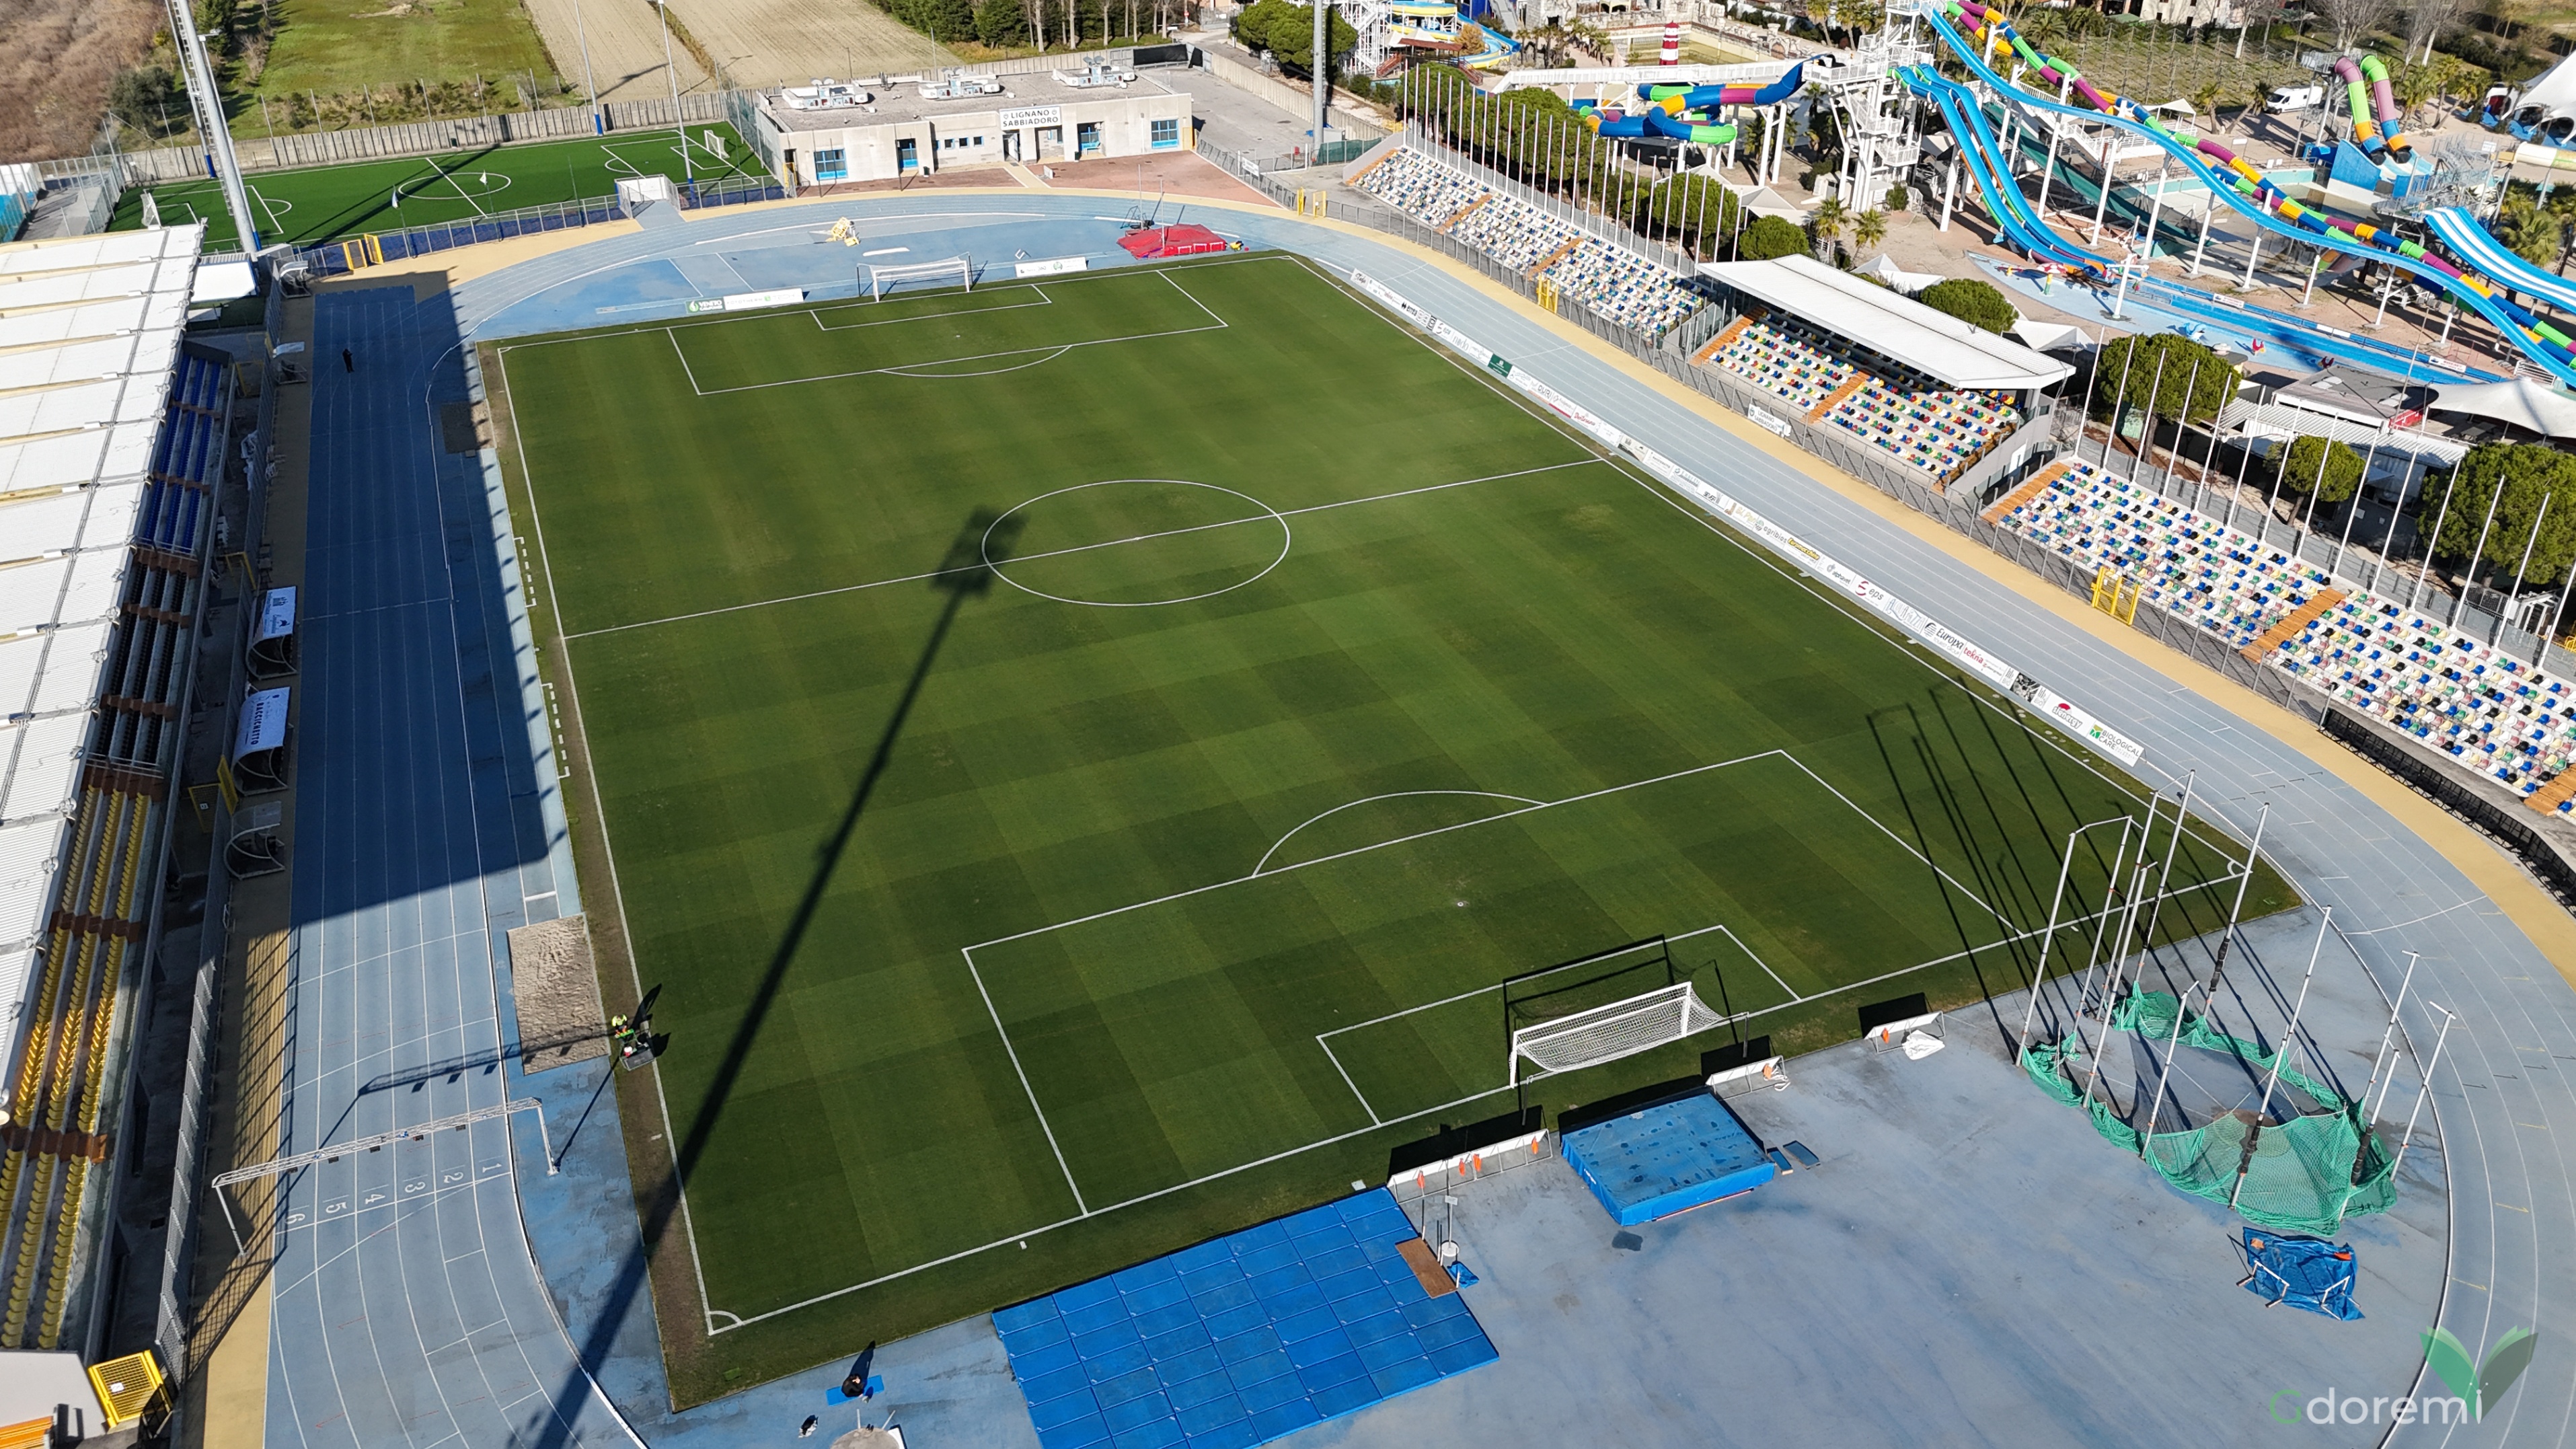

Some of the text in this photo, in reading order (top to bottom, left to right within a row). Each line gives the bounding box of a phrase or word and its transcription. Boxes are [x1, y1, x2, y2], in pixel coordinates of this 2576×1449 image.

[1011, 110, 1049, 118] LIGNANO
[1003, 116, 1059, 127] SABBIADORO
[1868, 587, 1884, 601] eps
[1936, 628, 1965, 650] Europa
[251, 702, 264, 745] BACCICHETTO
[2098, 735, 2116, 750] CARE
[2101, 730, 2139, 757] BIOLOGICAL
[482, 1162, 502, 1173] 1
[443, 1171, 464, 1183] 2
[405, 1181, 426, 1193] 3
[365, 1193, 386, 1204] 4
[326, 1201, 347, 1214] 5
[285, 1213, 305, 1225] 6
